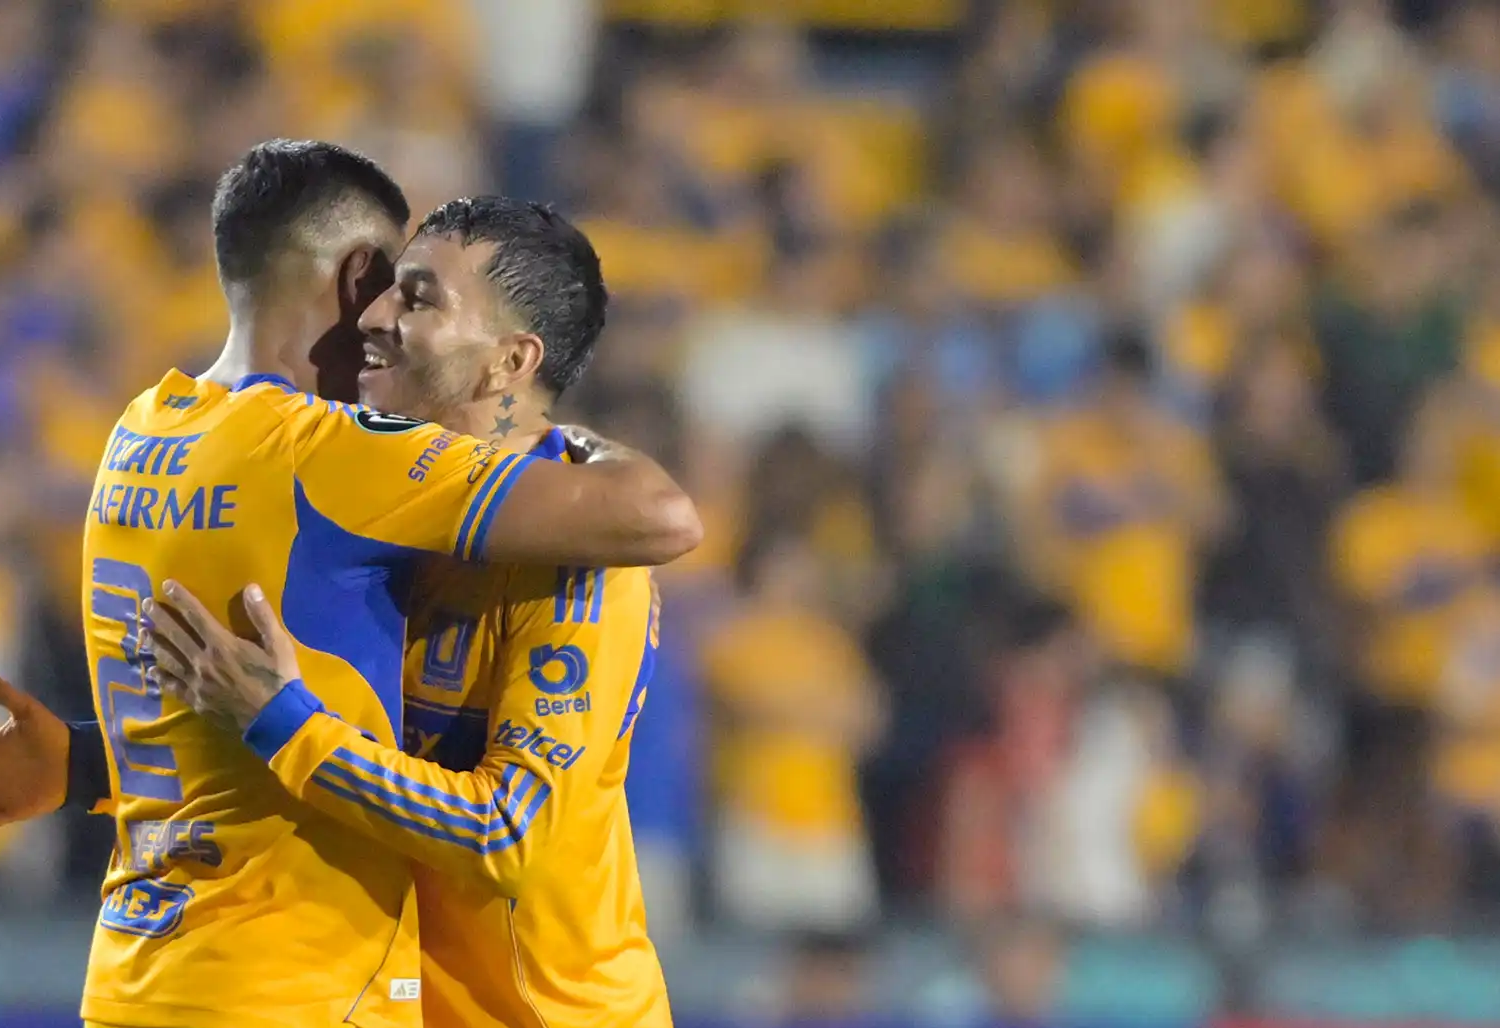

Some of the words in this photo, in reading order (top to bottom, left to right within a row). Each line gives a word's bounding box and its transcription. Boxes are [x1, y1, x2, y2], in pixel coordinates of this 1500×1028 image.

[106, 425, 208, 475] TECATE
[91, 484, 238, 530] AFIRME
[535, 692, 592, 717] Berel
[494, 719, 586, 771] telcel
